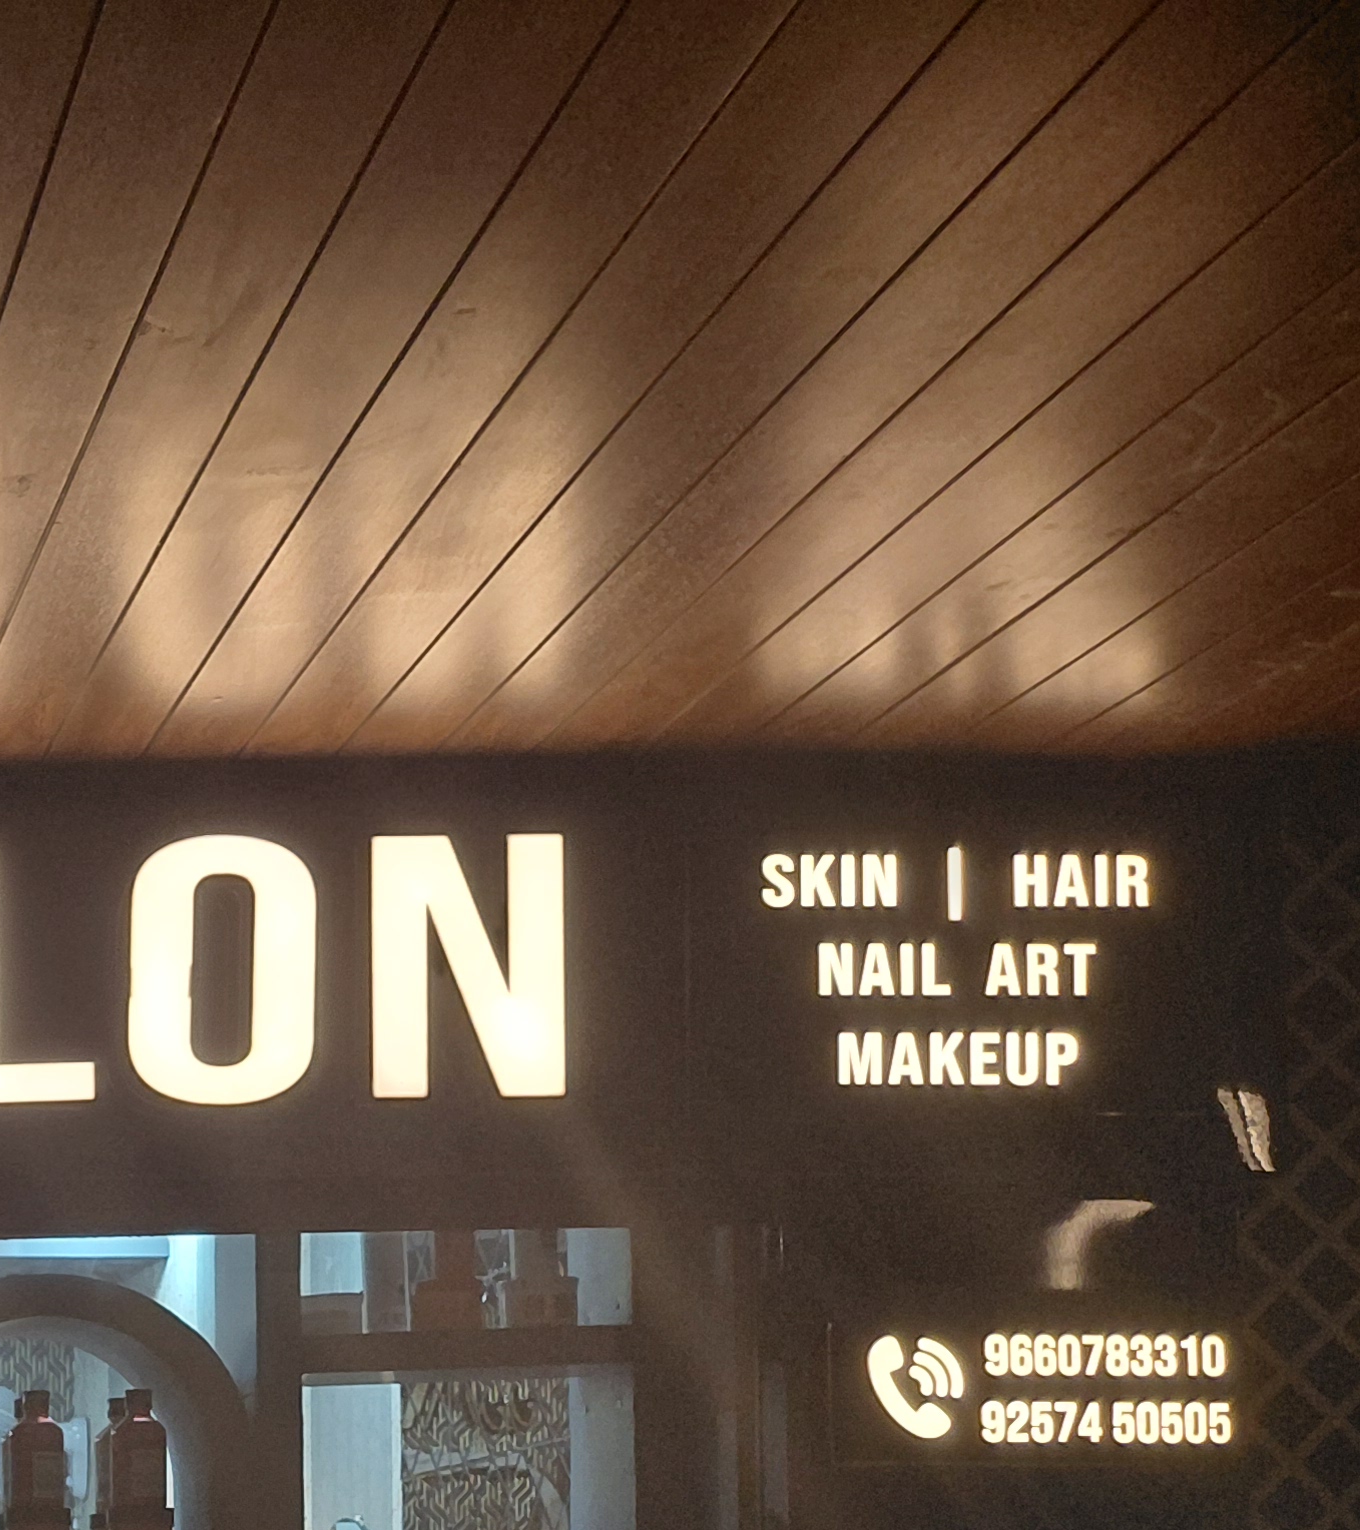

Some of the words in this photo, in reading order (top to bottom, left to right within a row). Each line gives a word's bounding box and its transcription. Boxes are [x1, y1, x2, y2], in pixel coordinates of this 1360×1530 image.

[760, 853, 899, 908] SKIN
[1012, 853, 1152, 908] HAIR
[817, 942, 952, 997] NAIL
[983, 942, 1098, 997] ART
[837, 1031, 1081, 1087] MAKEUP
[983, 1332, 1227, 1378] 9660783310
[980, 1399, 1104, 1444] 92574
[1111, 1400, 1233, 1445] 50505
